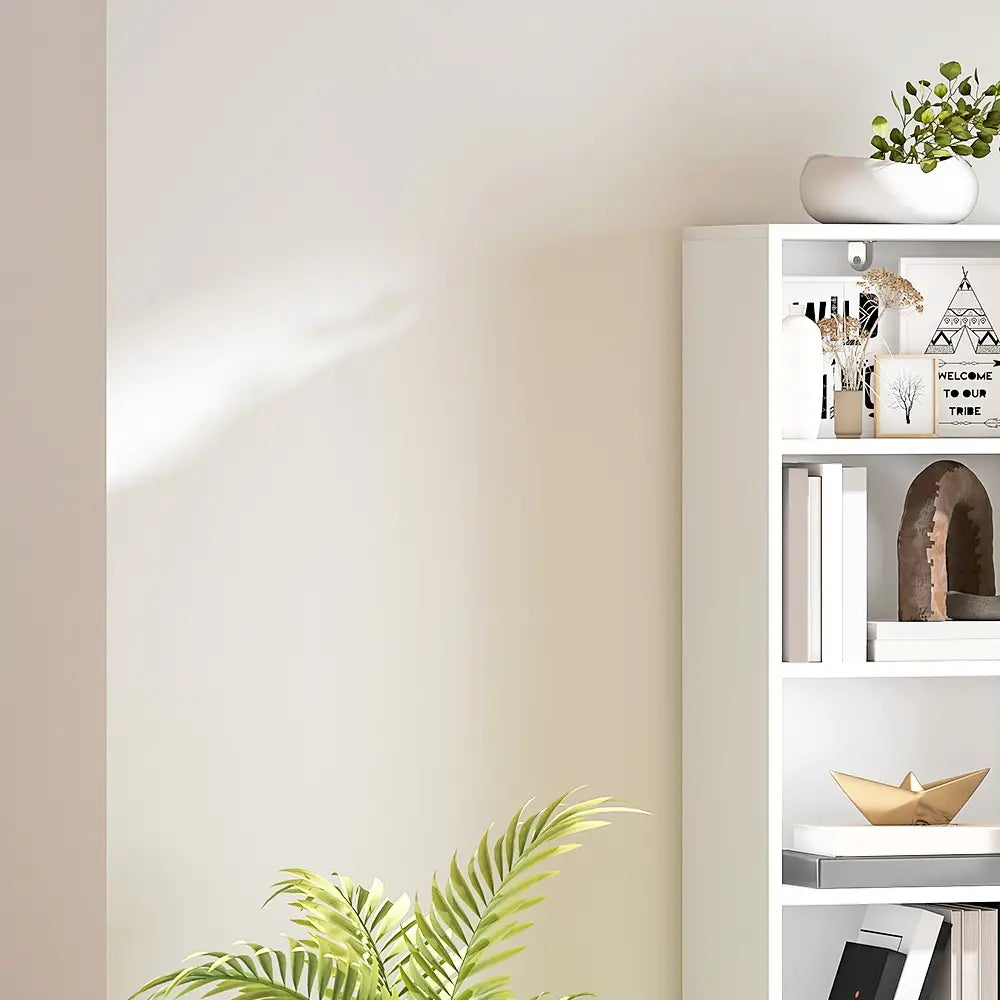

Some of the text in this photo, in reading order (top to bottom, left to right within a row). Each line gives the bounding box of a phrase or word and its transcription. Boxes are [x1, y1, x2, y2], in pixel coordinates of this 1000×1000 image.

[938, 371, 993, 381] WELCOME
[943, 389, 987, 398] TO OUR
[949, 406, 982, 416] TRIBE
